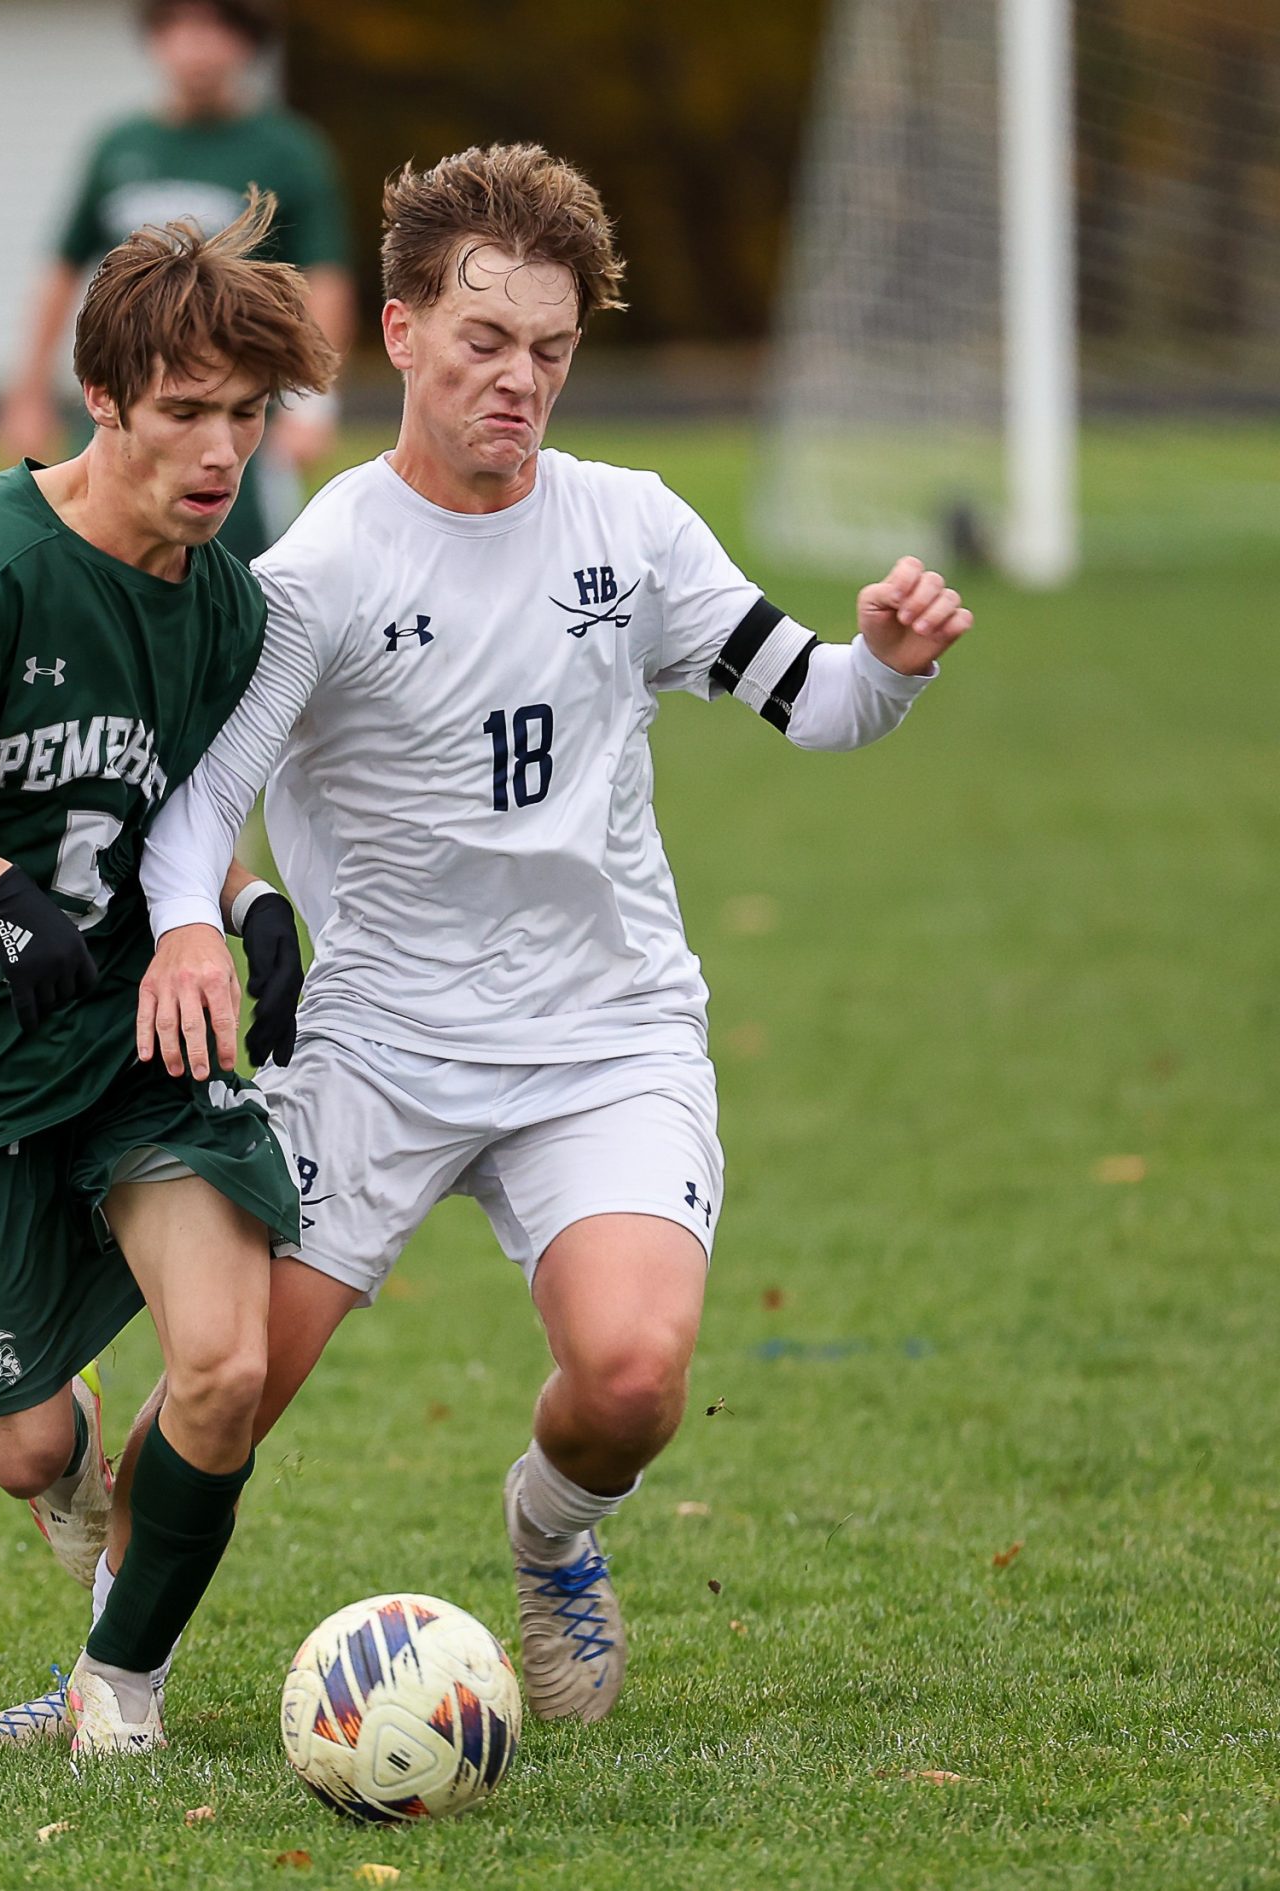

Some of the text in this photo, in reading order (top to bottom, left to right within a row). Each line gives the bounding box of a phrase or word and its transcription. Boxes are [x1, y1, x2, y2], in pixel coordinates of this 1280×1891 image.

[573, 566, 619, 606] HB
[483, 703, 554, 812] 18
[293, 1153, 319, 1196] B
